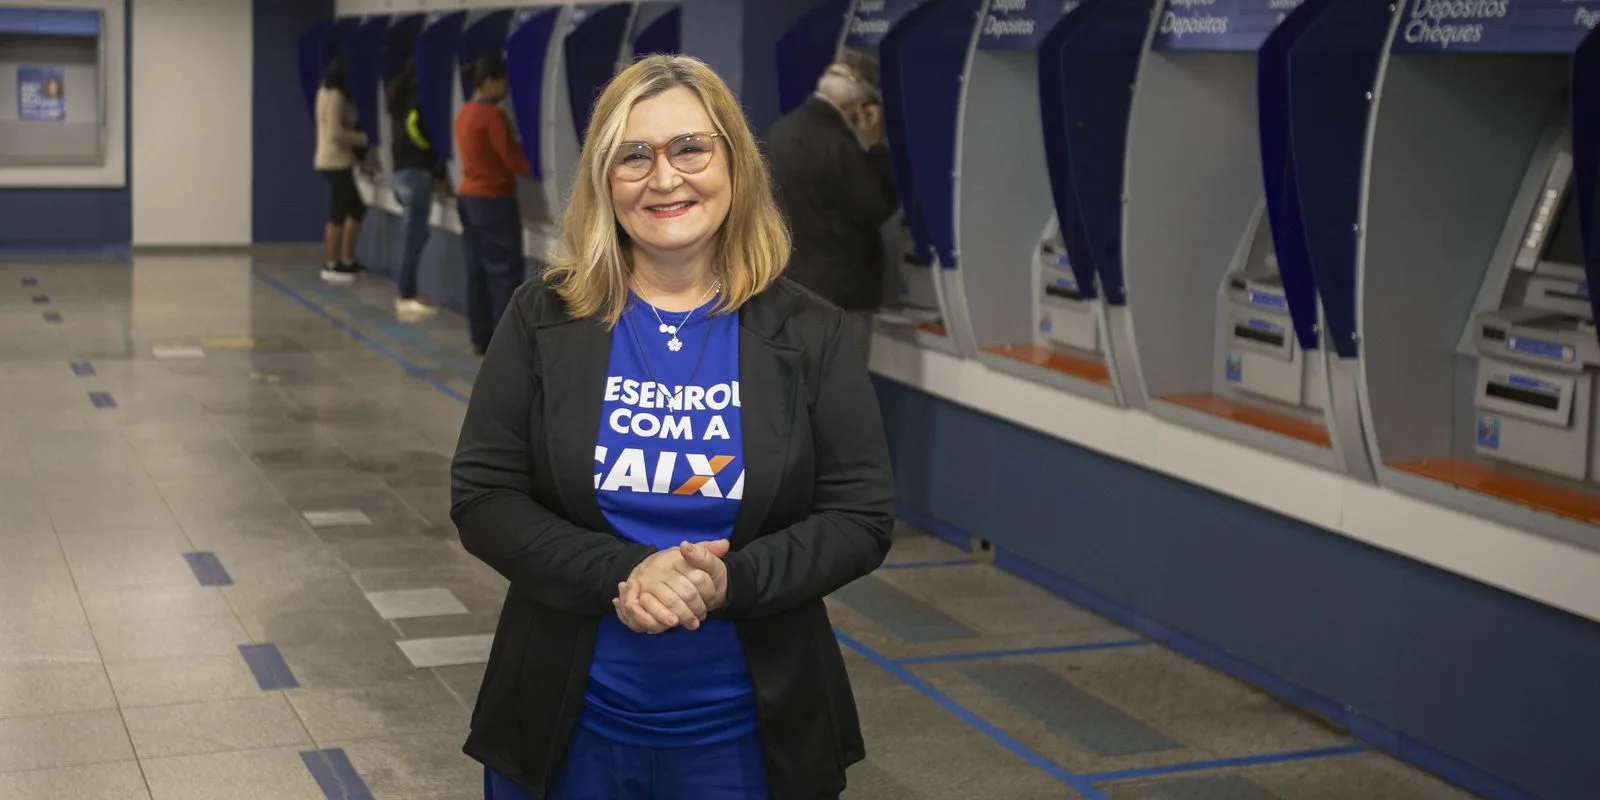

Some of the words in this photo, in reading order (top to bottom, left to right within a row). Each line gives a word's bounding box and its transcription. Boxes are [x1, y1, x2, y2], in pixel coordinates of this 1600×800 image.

[1405, 17, 1484, 49] Cheques
[609, 408, 693, 440] COM
[702, 415, 731, 440] A
